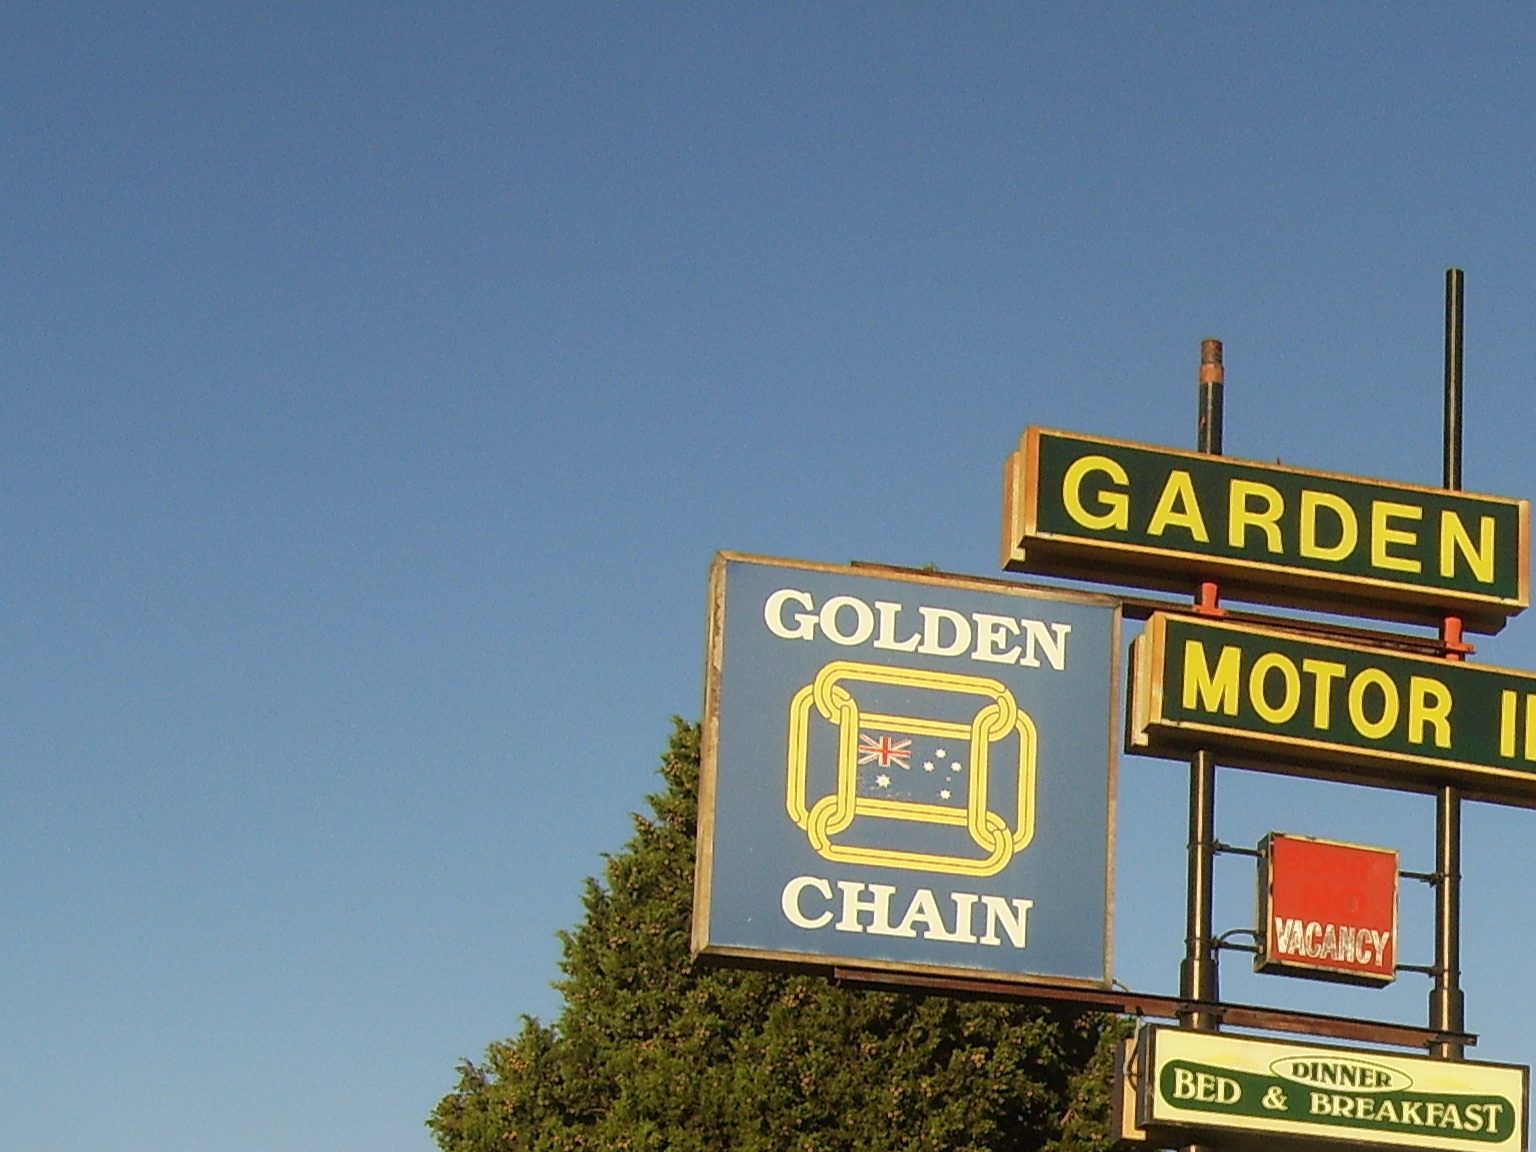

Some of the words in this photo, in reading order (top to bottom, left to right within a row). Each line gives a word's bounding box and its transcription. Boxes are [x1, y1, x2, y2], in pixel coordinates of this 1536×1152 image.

[1062, 455, 1495, 583] GARDEN
[763, 588, 1072, 671] GOLDEN
[1182, 640, 1453, 748] MOTOR
[781, 875, 1034, 949] CHAIN
[1274, 916, 1390, 967] VACANCY
[1173, 1067, 1242, 1104] BED
[1262, 1085, 1288, 1111] &
[1309, 1092, 1503, 1134] BREAKFAST
[1291, 1061, 1393, 1088] DINNER
